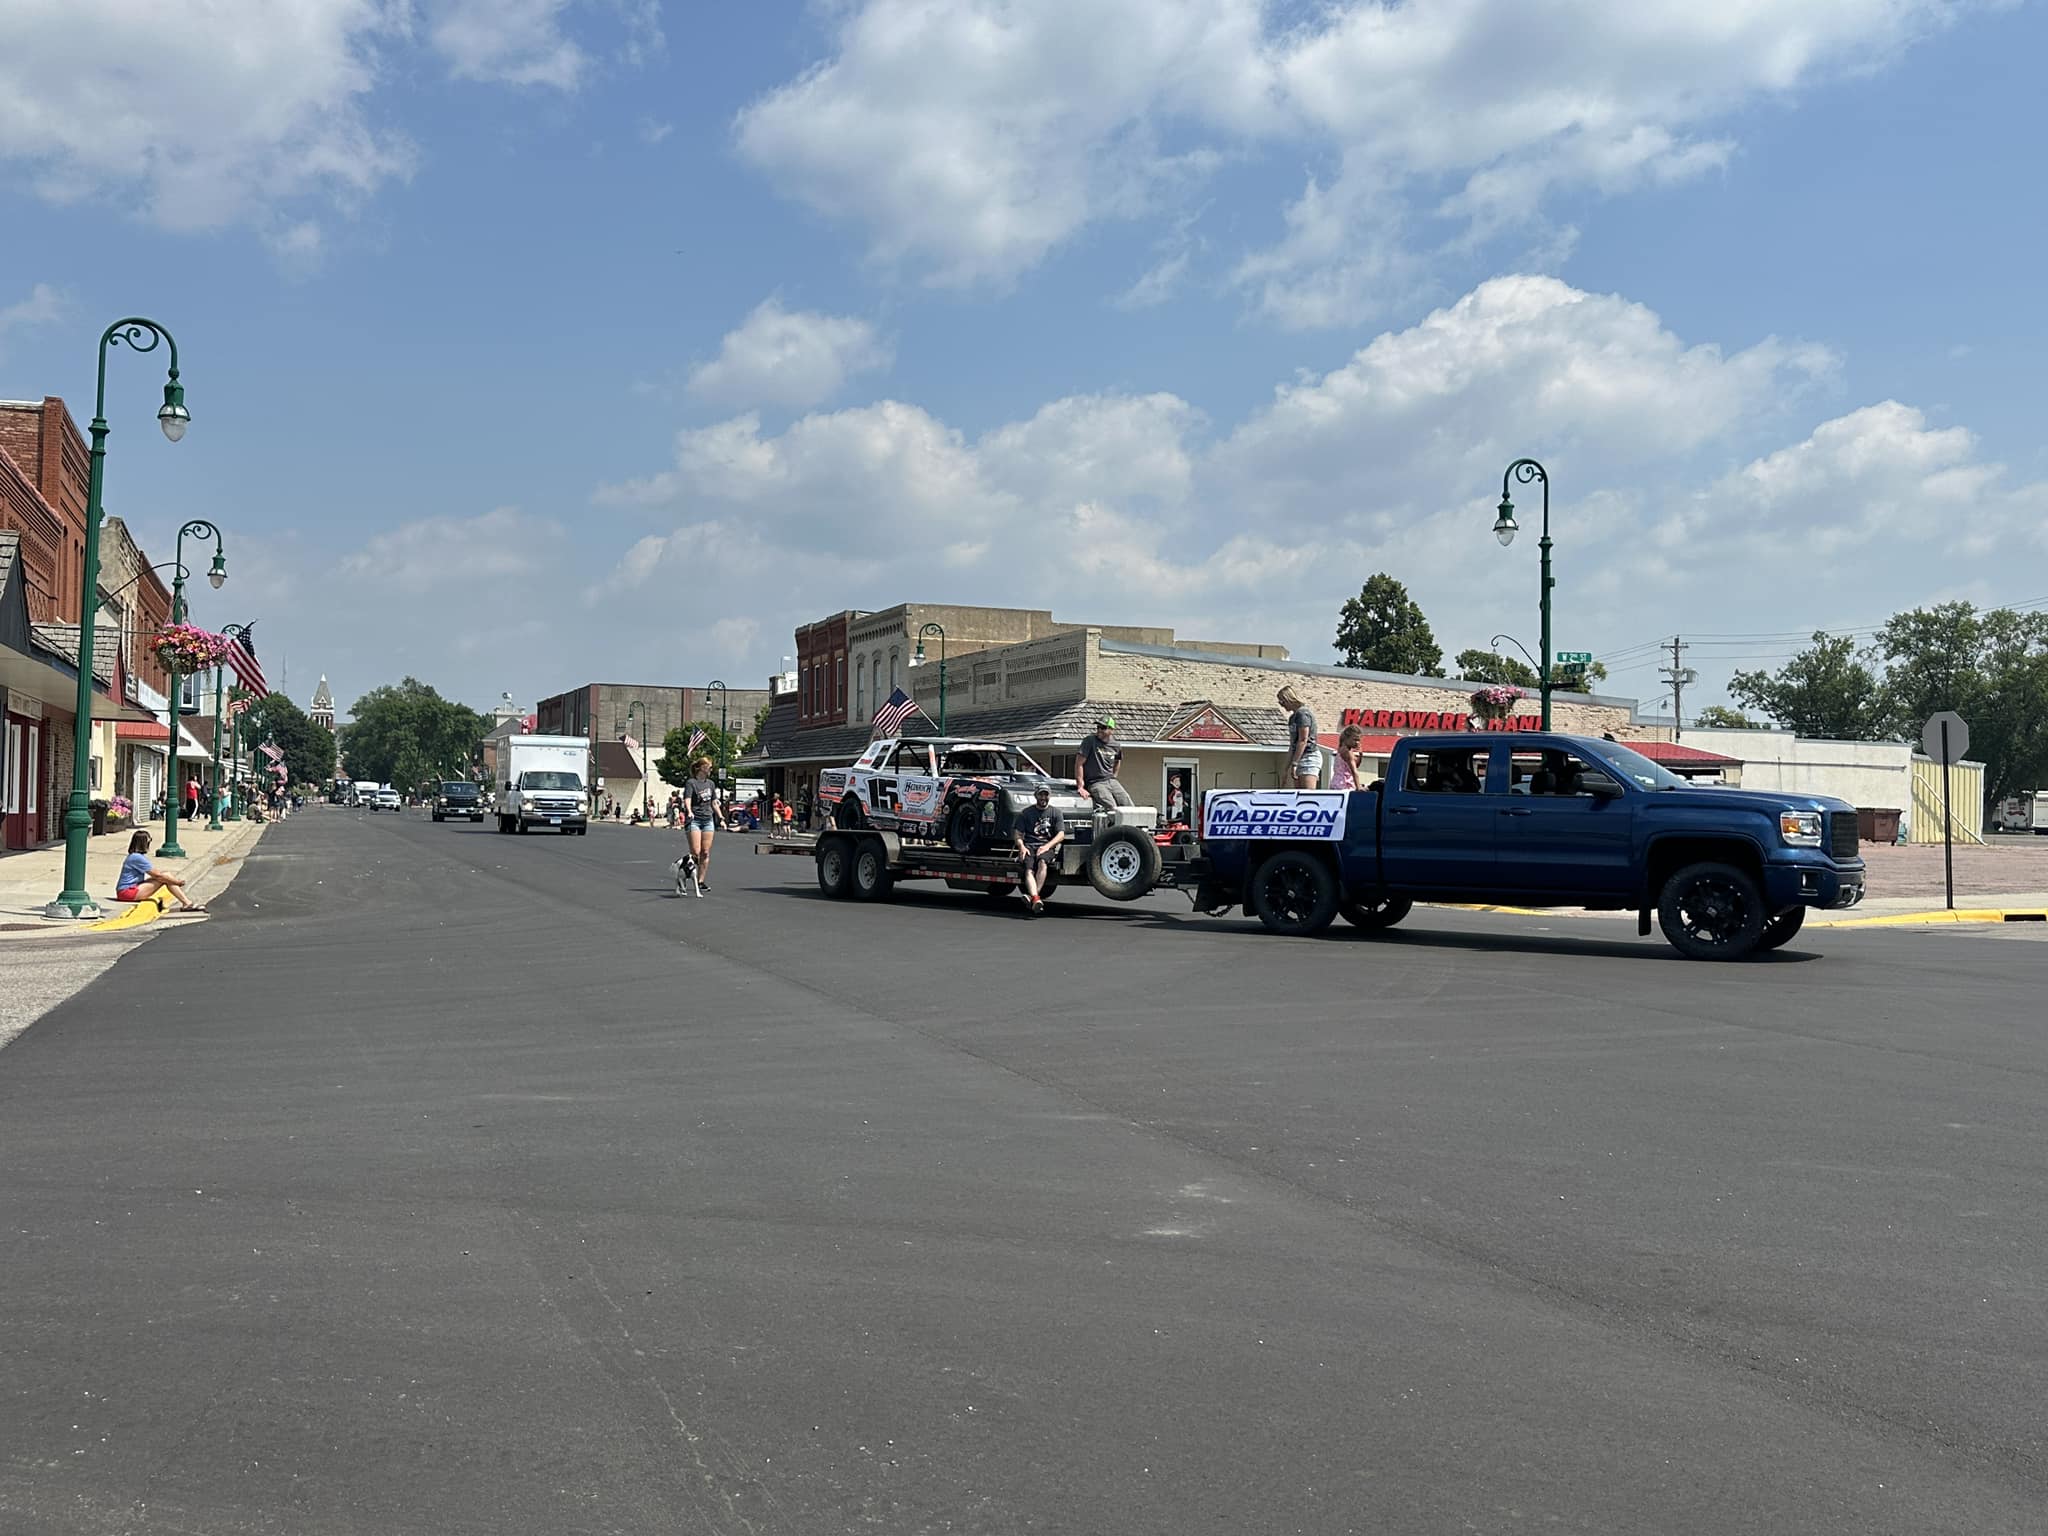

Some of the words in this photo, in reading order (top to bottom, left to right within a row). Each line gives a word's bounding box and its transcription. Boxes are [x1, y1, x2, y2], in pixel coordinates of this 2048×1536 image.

[1344, 709, 1468, 730] HARDWARE
[867, 778, 898, 810] 15
[1211, 810, 1339, 823] MADISON
[1215, 825, 1249, 834] TIRE
[1252, 825, 1263, 835] &
[1268, 825, 1326, 835] REPAIR
